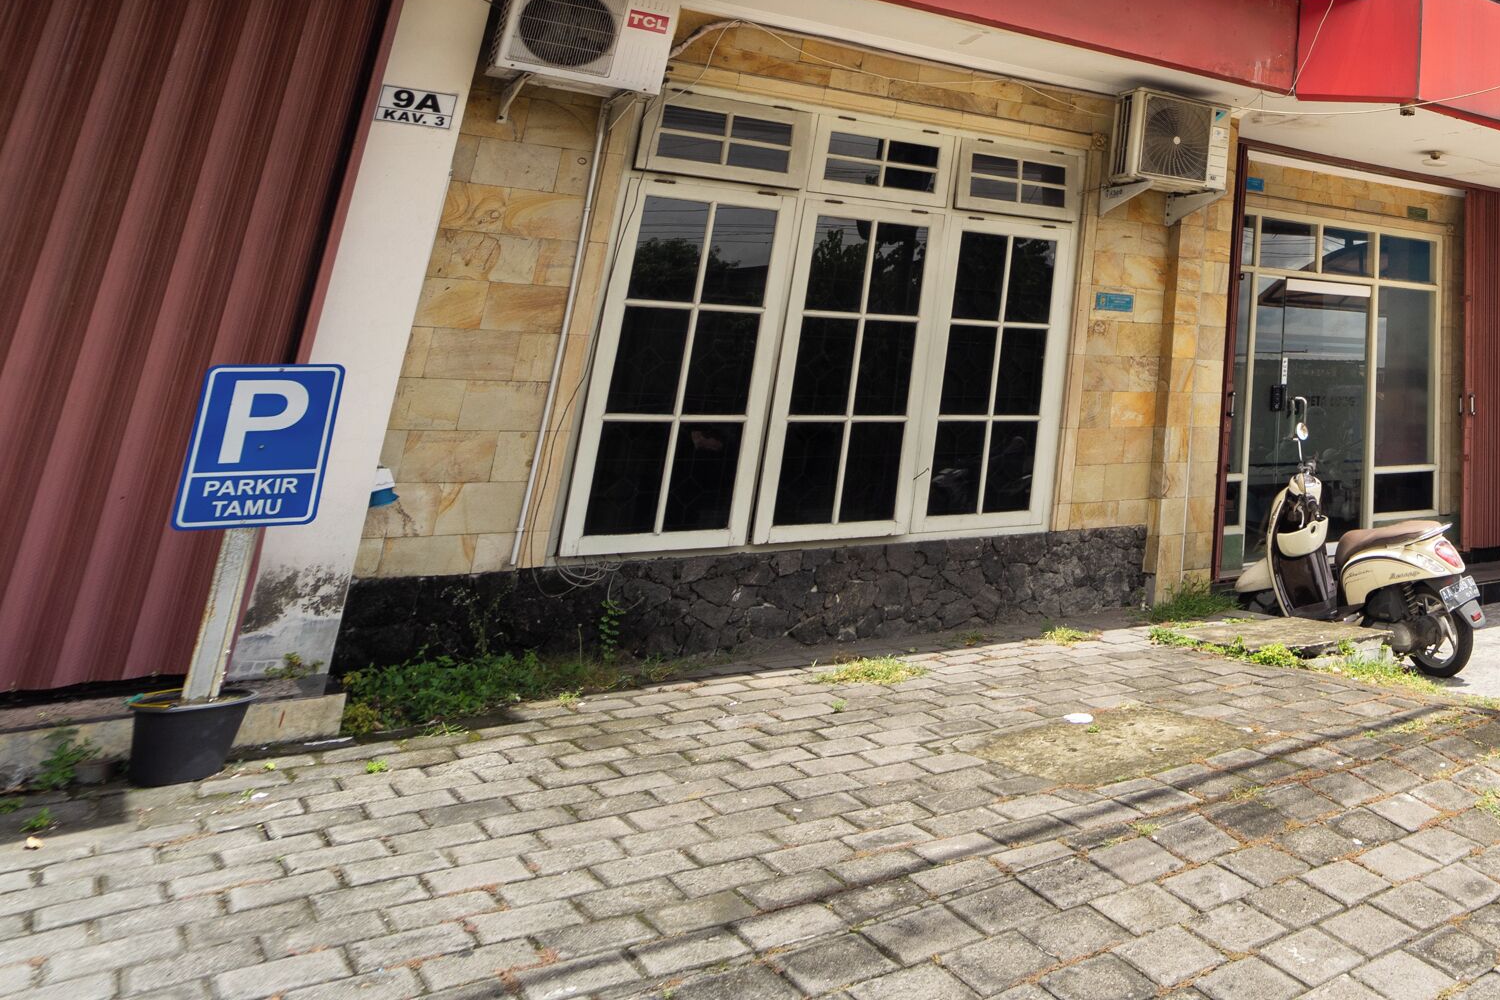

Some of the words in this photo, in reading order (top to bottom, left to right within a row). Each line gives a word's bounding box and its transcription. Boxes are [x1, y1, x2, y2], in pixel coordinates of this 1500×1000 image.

[630, 13, 667, 31] TCL
[392, 89, 441, 113] 9A
[383, 109, 427, 125] KAV.
[434, 116, 445, 127] 3
[217, 379, 310, 464] P
[202, 477, 298, 497] PARKIR
[212, 499, 282, 517] TAMU
